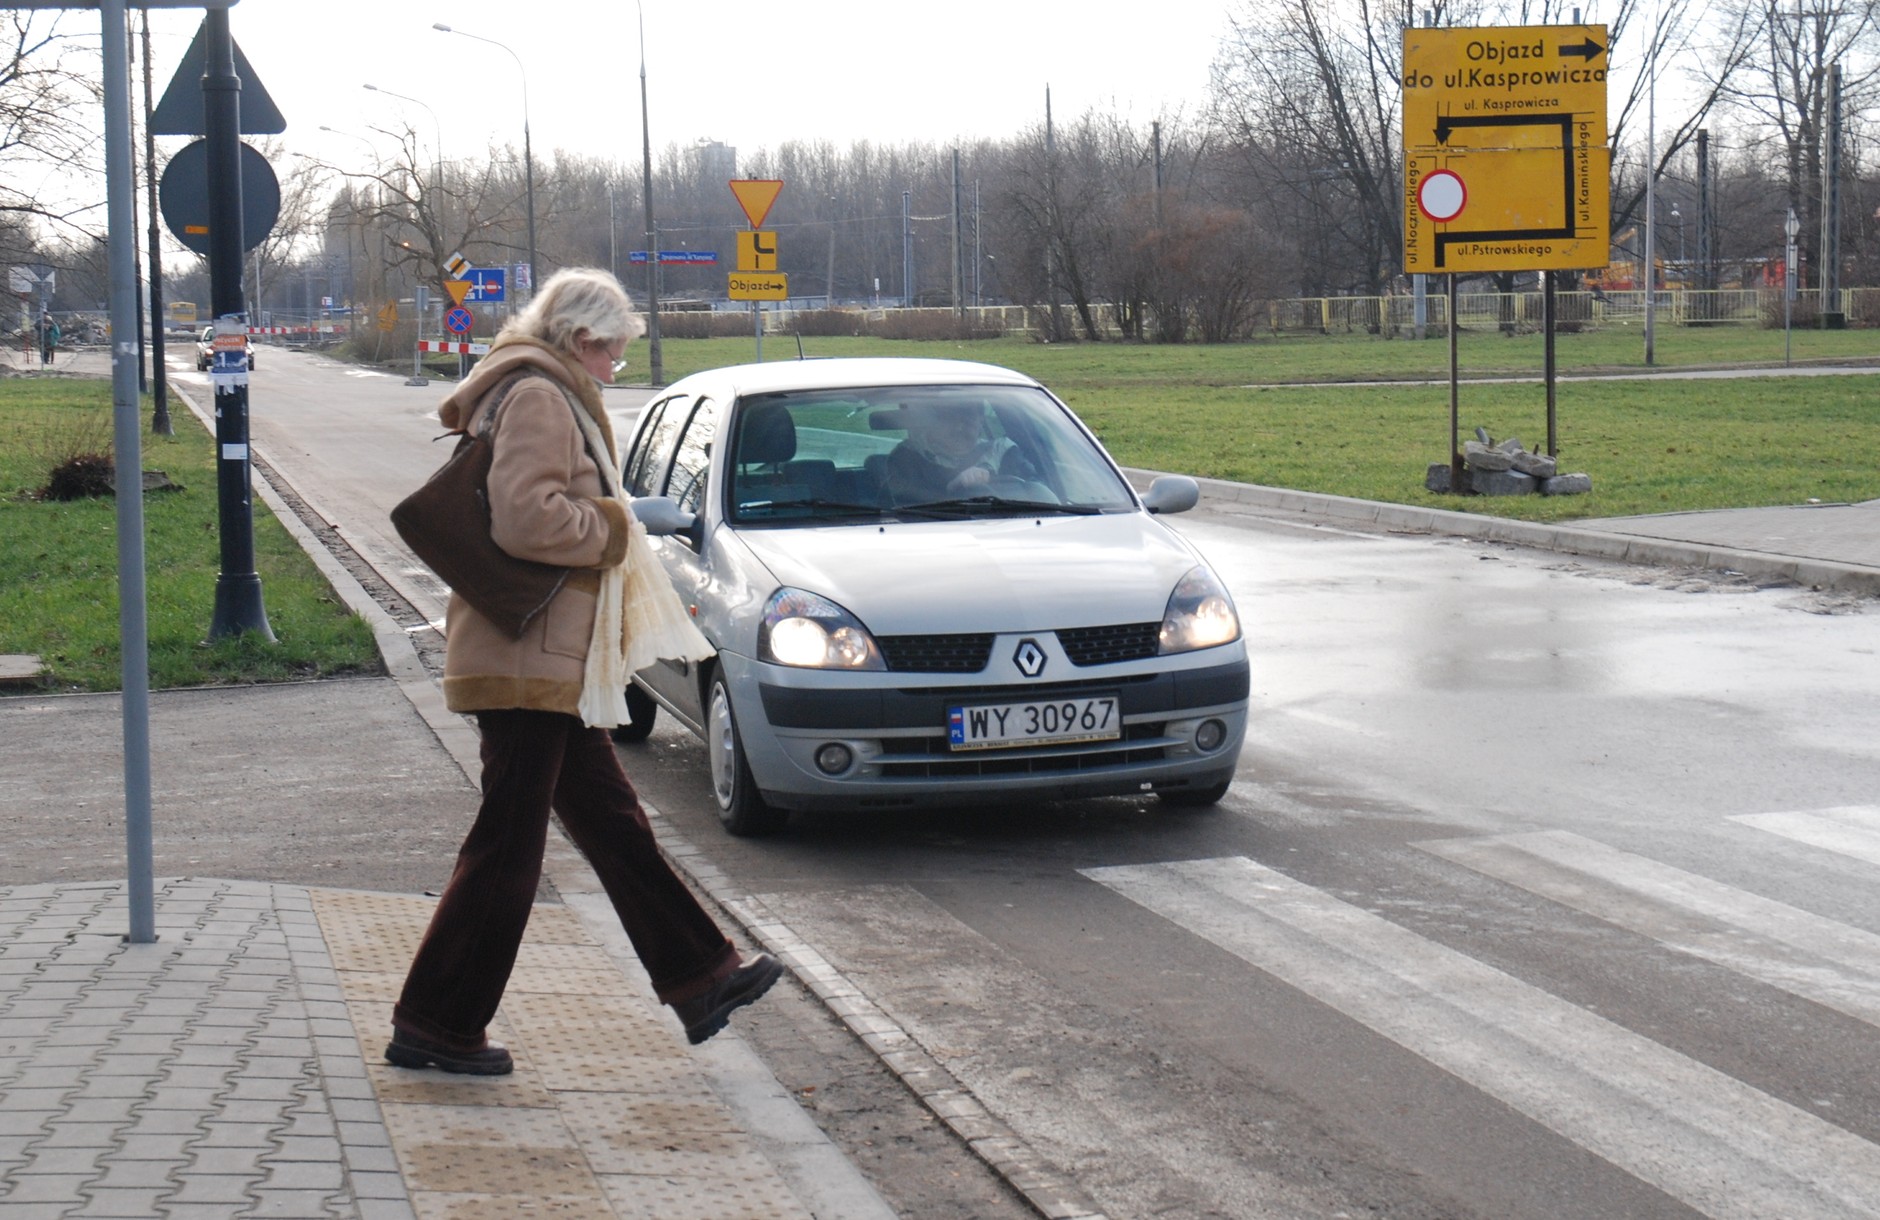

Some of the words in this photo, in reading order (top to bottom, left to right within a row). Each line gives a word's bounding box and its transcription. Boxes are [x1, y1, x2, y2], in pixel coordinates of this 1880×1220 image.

[1466, 40, 1544, 64] Objazd
[1404, 69, 1434, 90] do
[1444, 65, 1607, 92] ul.Kasprowicza
[1464, 99, 1478, 111] ul.
[1483, 96, 1559, 112] Kasprowicza
[1457, 243, 1552, 257] ul.Pstrowskiego
[729, 279, 770, 293] Objazd
[969, 707, 1011, 739] WY
[1024, 700, 1115, 735] 30967
[951, 729, 963, 738] PL
